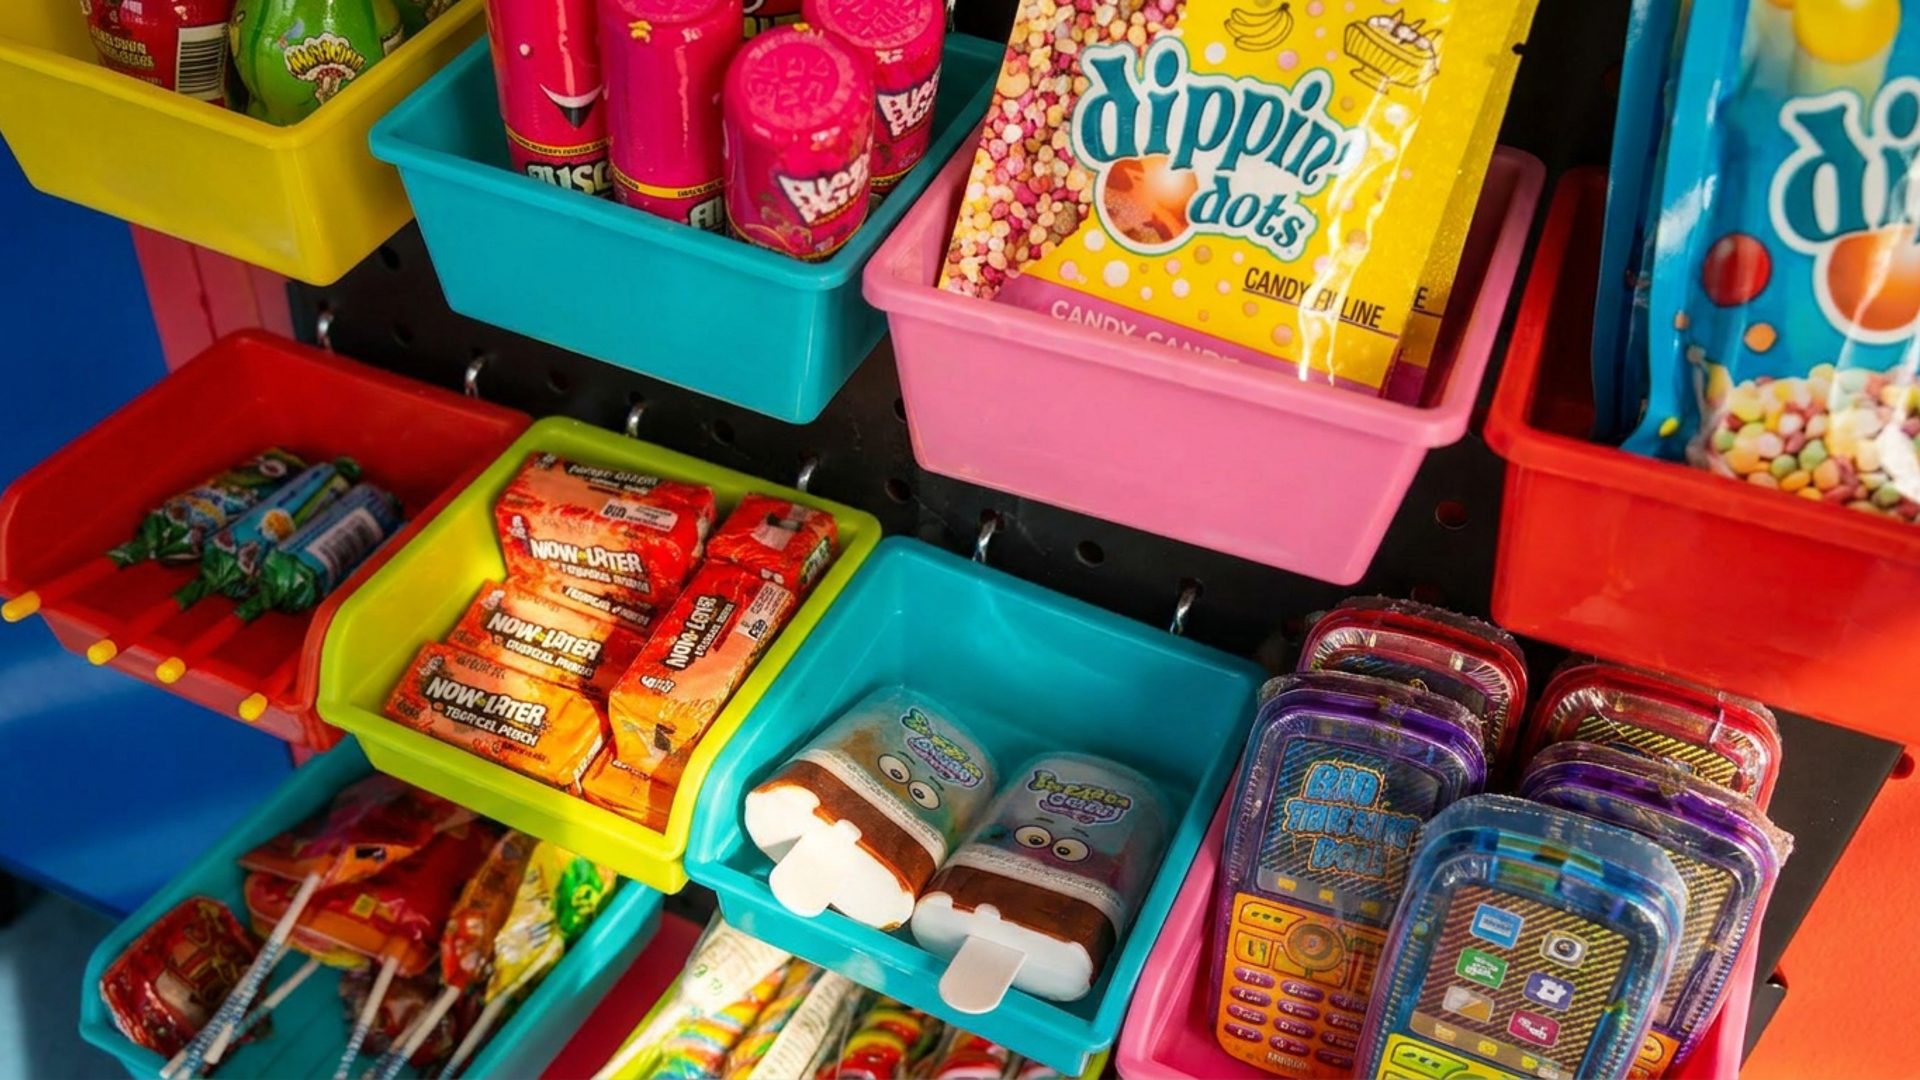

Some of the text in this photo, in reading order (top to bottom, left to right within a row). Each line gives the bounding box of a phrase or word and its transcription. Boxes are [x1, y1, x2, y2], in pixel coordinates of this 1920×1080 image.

[1189, 175, 1305, 248] dots
[1245, 267, 1311, 304] CANDY
[1051, 300, 1137, 336] CANDY
[530, 539, 578, 563] NOW
[487, 612, 542, 642] NOW
[426, 676, 546, 727] NOW LATER
